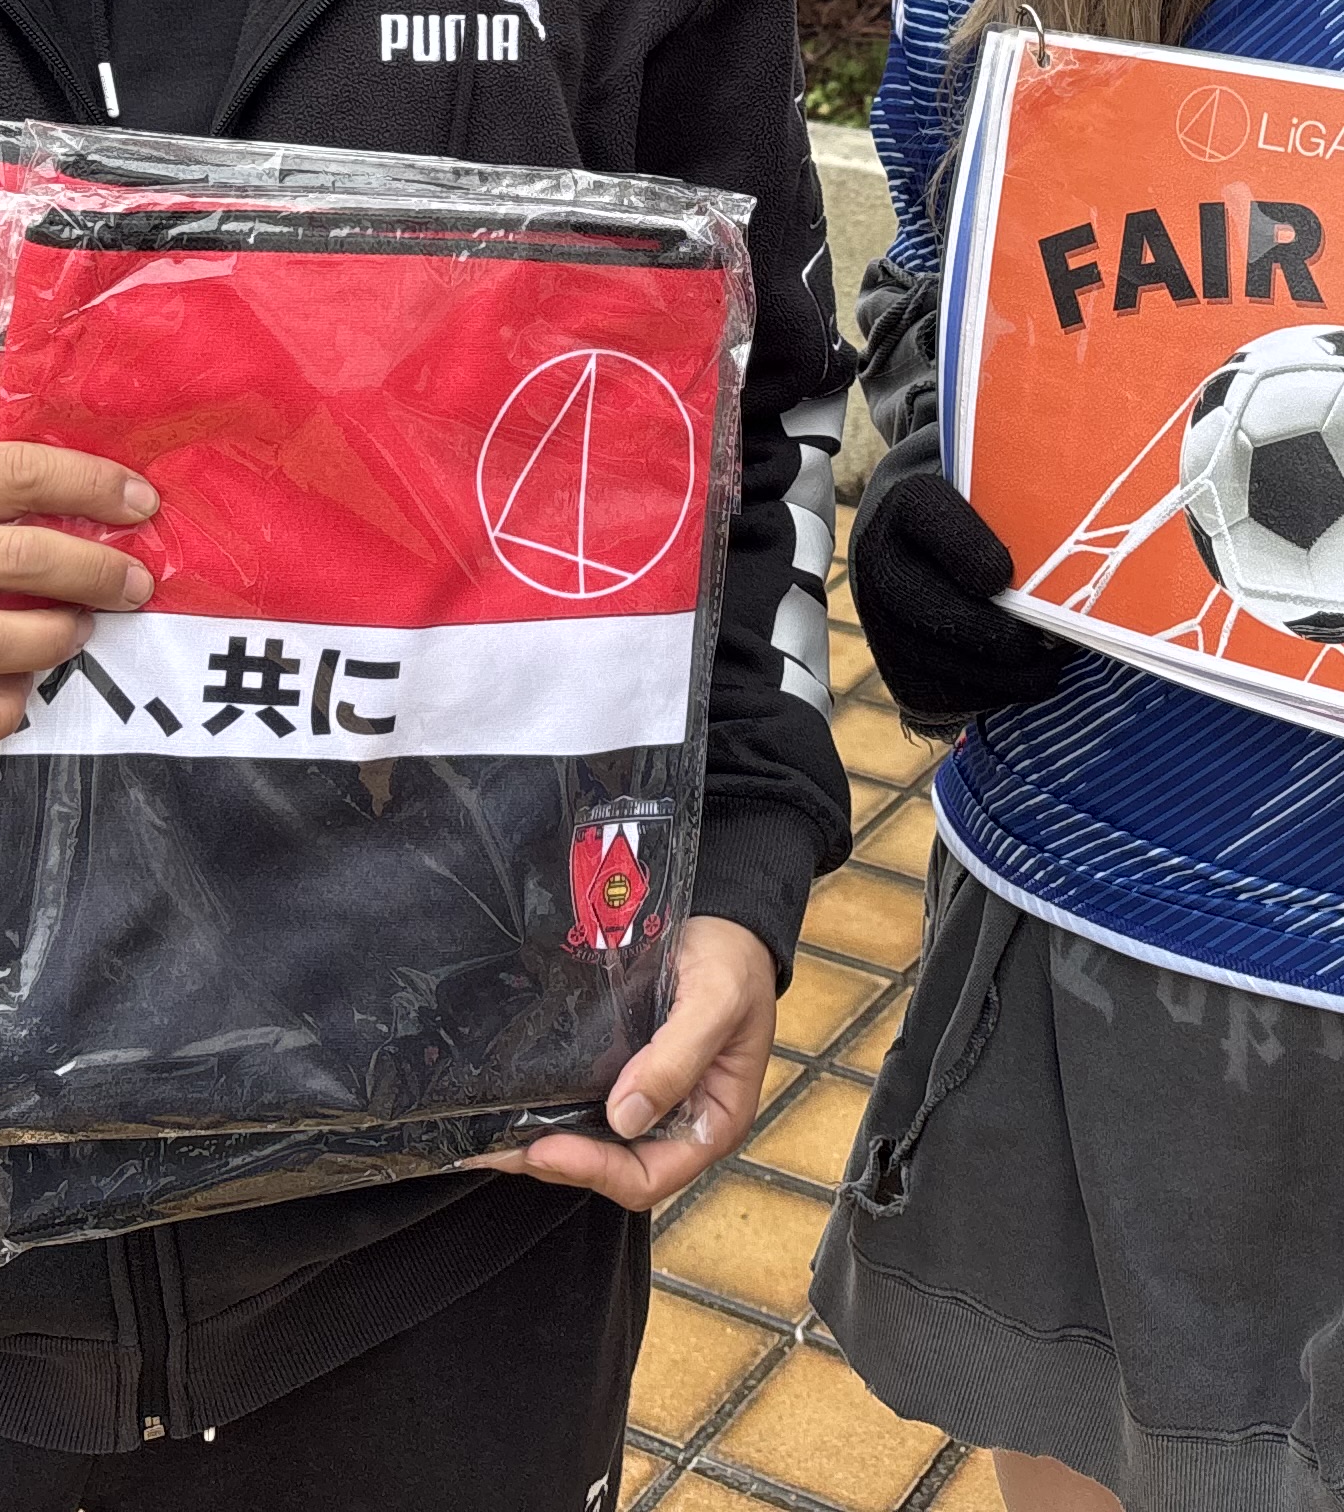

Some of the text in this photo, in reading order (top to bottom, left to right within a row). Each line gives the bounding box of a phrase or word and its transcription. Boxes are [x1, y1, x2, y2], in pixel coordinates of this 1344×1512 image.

[380, 14, 520, 62] PUMA
[1037, 200, 1326, 332] FAIR
[15, 636, 401, 739] へ、共に
